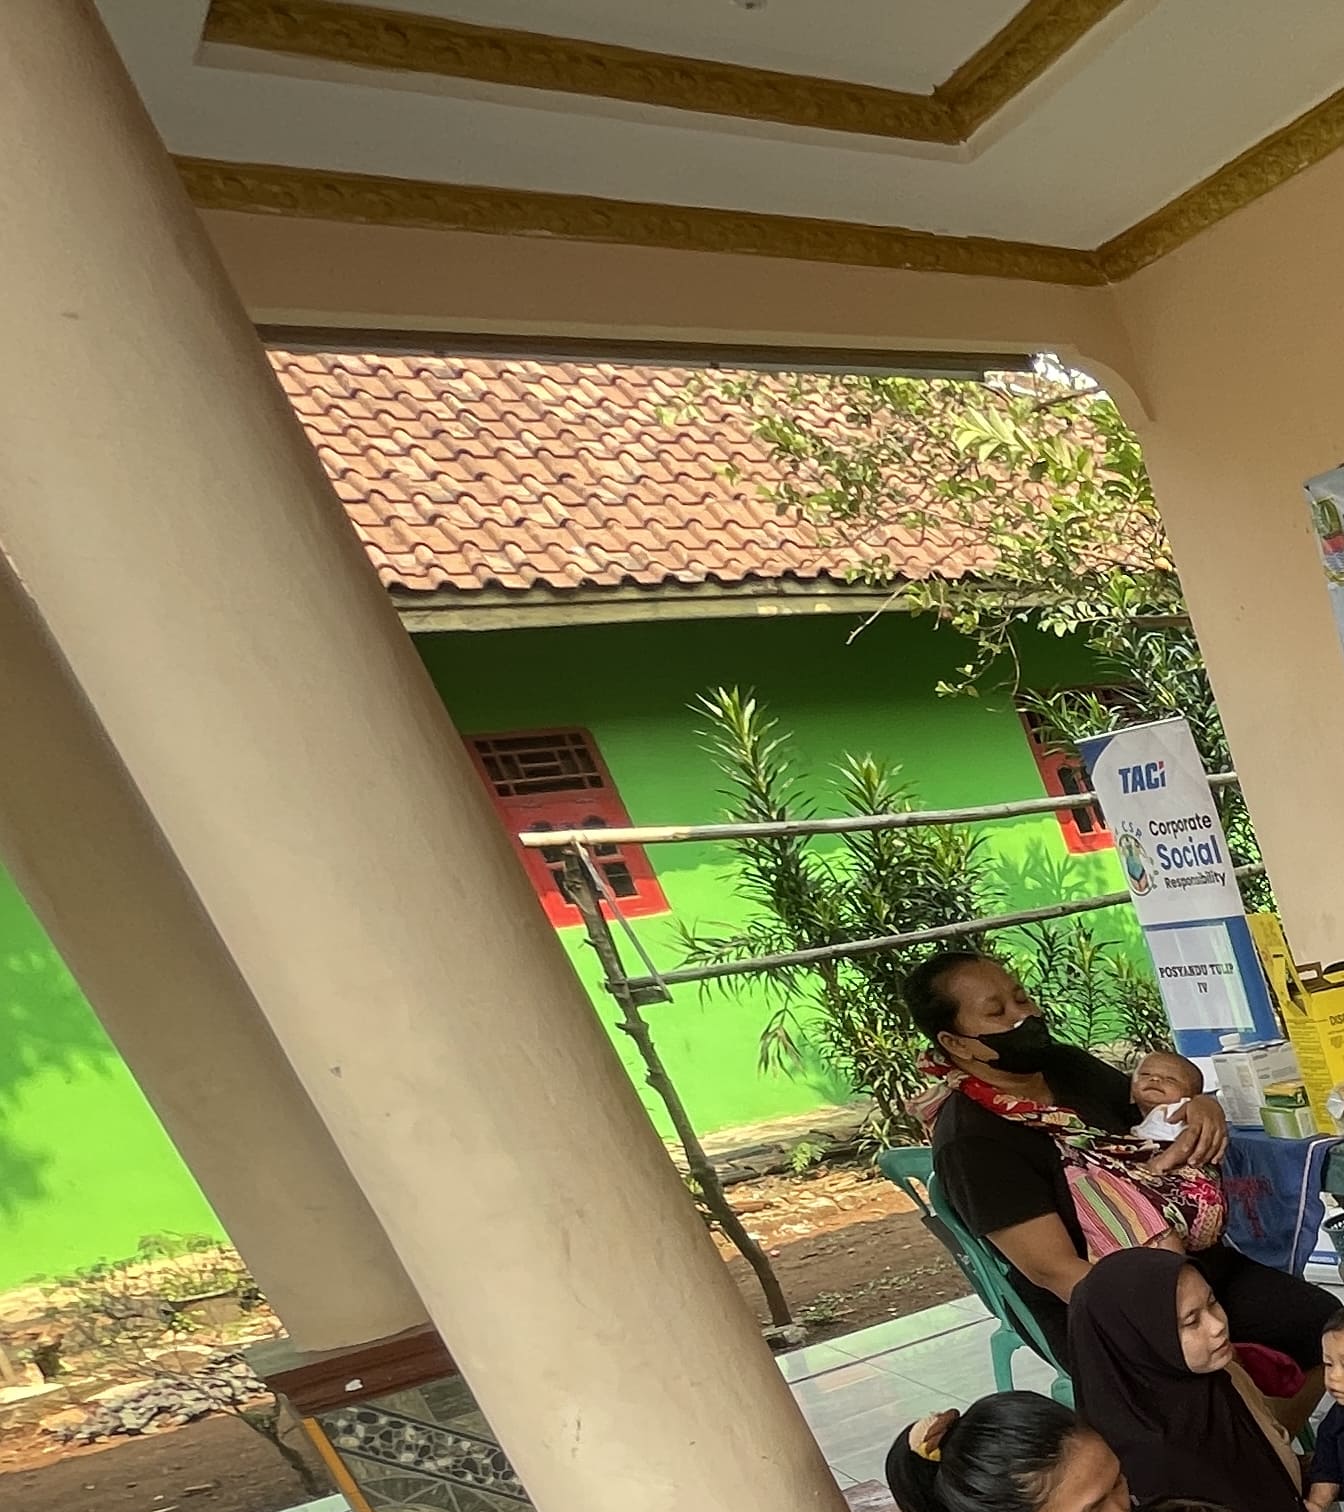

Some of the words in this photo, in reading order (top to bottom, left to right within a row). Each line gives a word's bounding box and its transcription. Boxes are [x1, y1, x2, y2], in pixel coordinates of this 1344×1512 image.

[1149, 813, 1212, 839] Corporate
[1156, 835, 1222, 871] Social
[1164, 870, 1226, 890] Responsibility
[1159, 964, 1208, 979] POSYANDU
[1208, 963, 1234, 976] TULIP
[1197, 982, 1208, 993] IV
